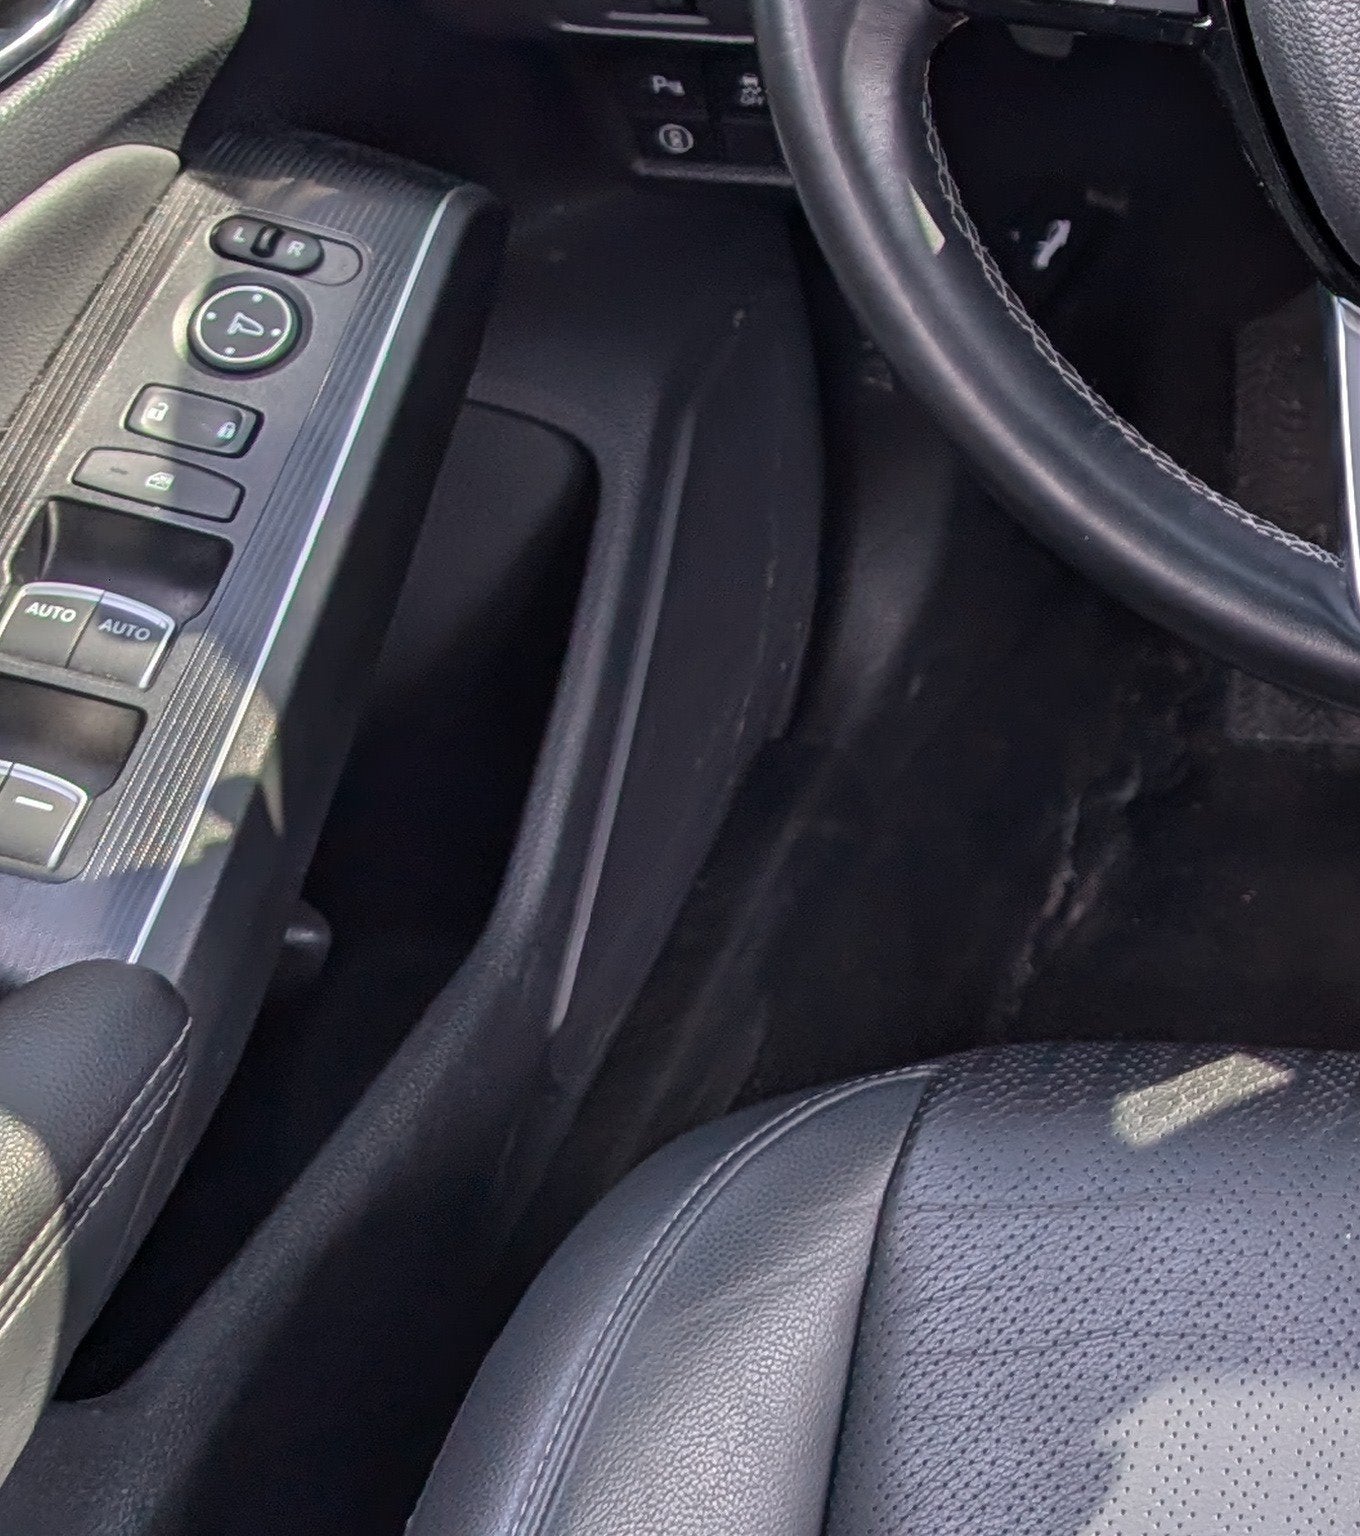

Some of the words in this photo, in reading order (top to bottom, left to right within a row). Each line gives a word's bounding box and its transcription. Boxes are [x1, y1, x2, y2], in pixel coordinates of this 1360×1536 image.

[233, 226, 246, 242] L
[287, 240, 306, 257] R
[24, 601, 77, 623] AUTO
[99, 617, 151, 641] AUTO
